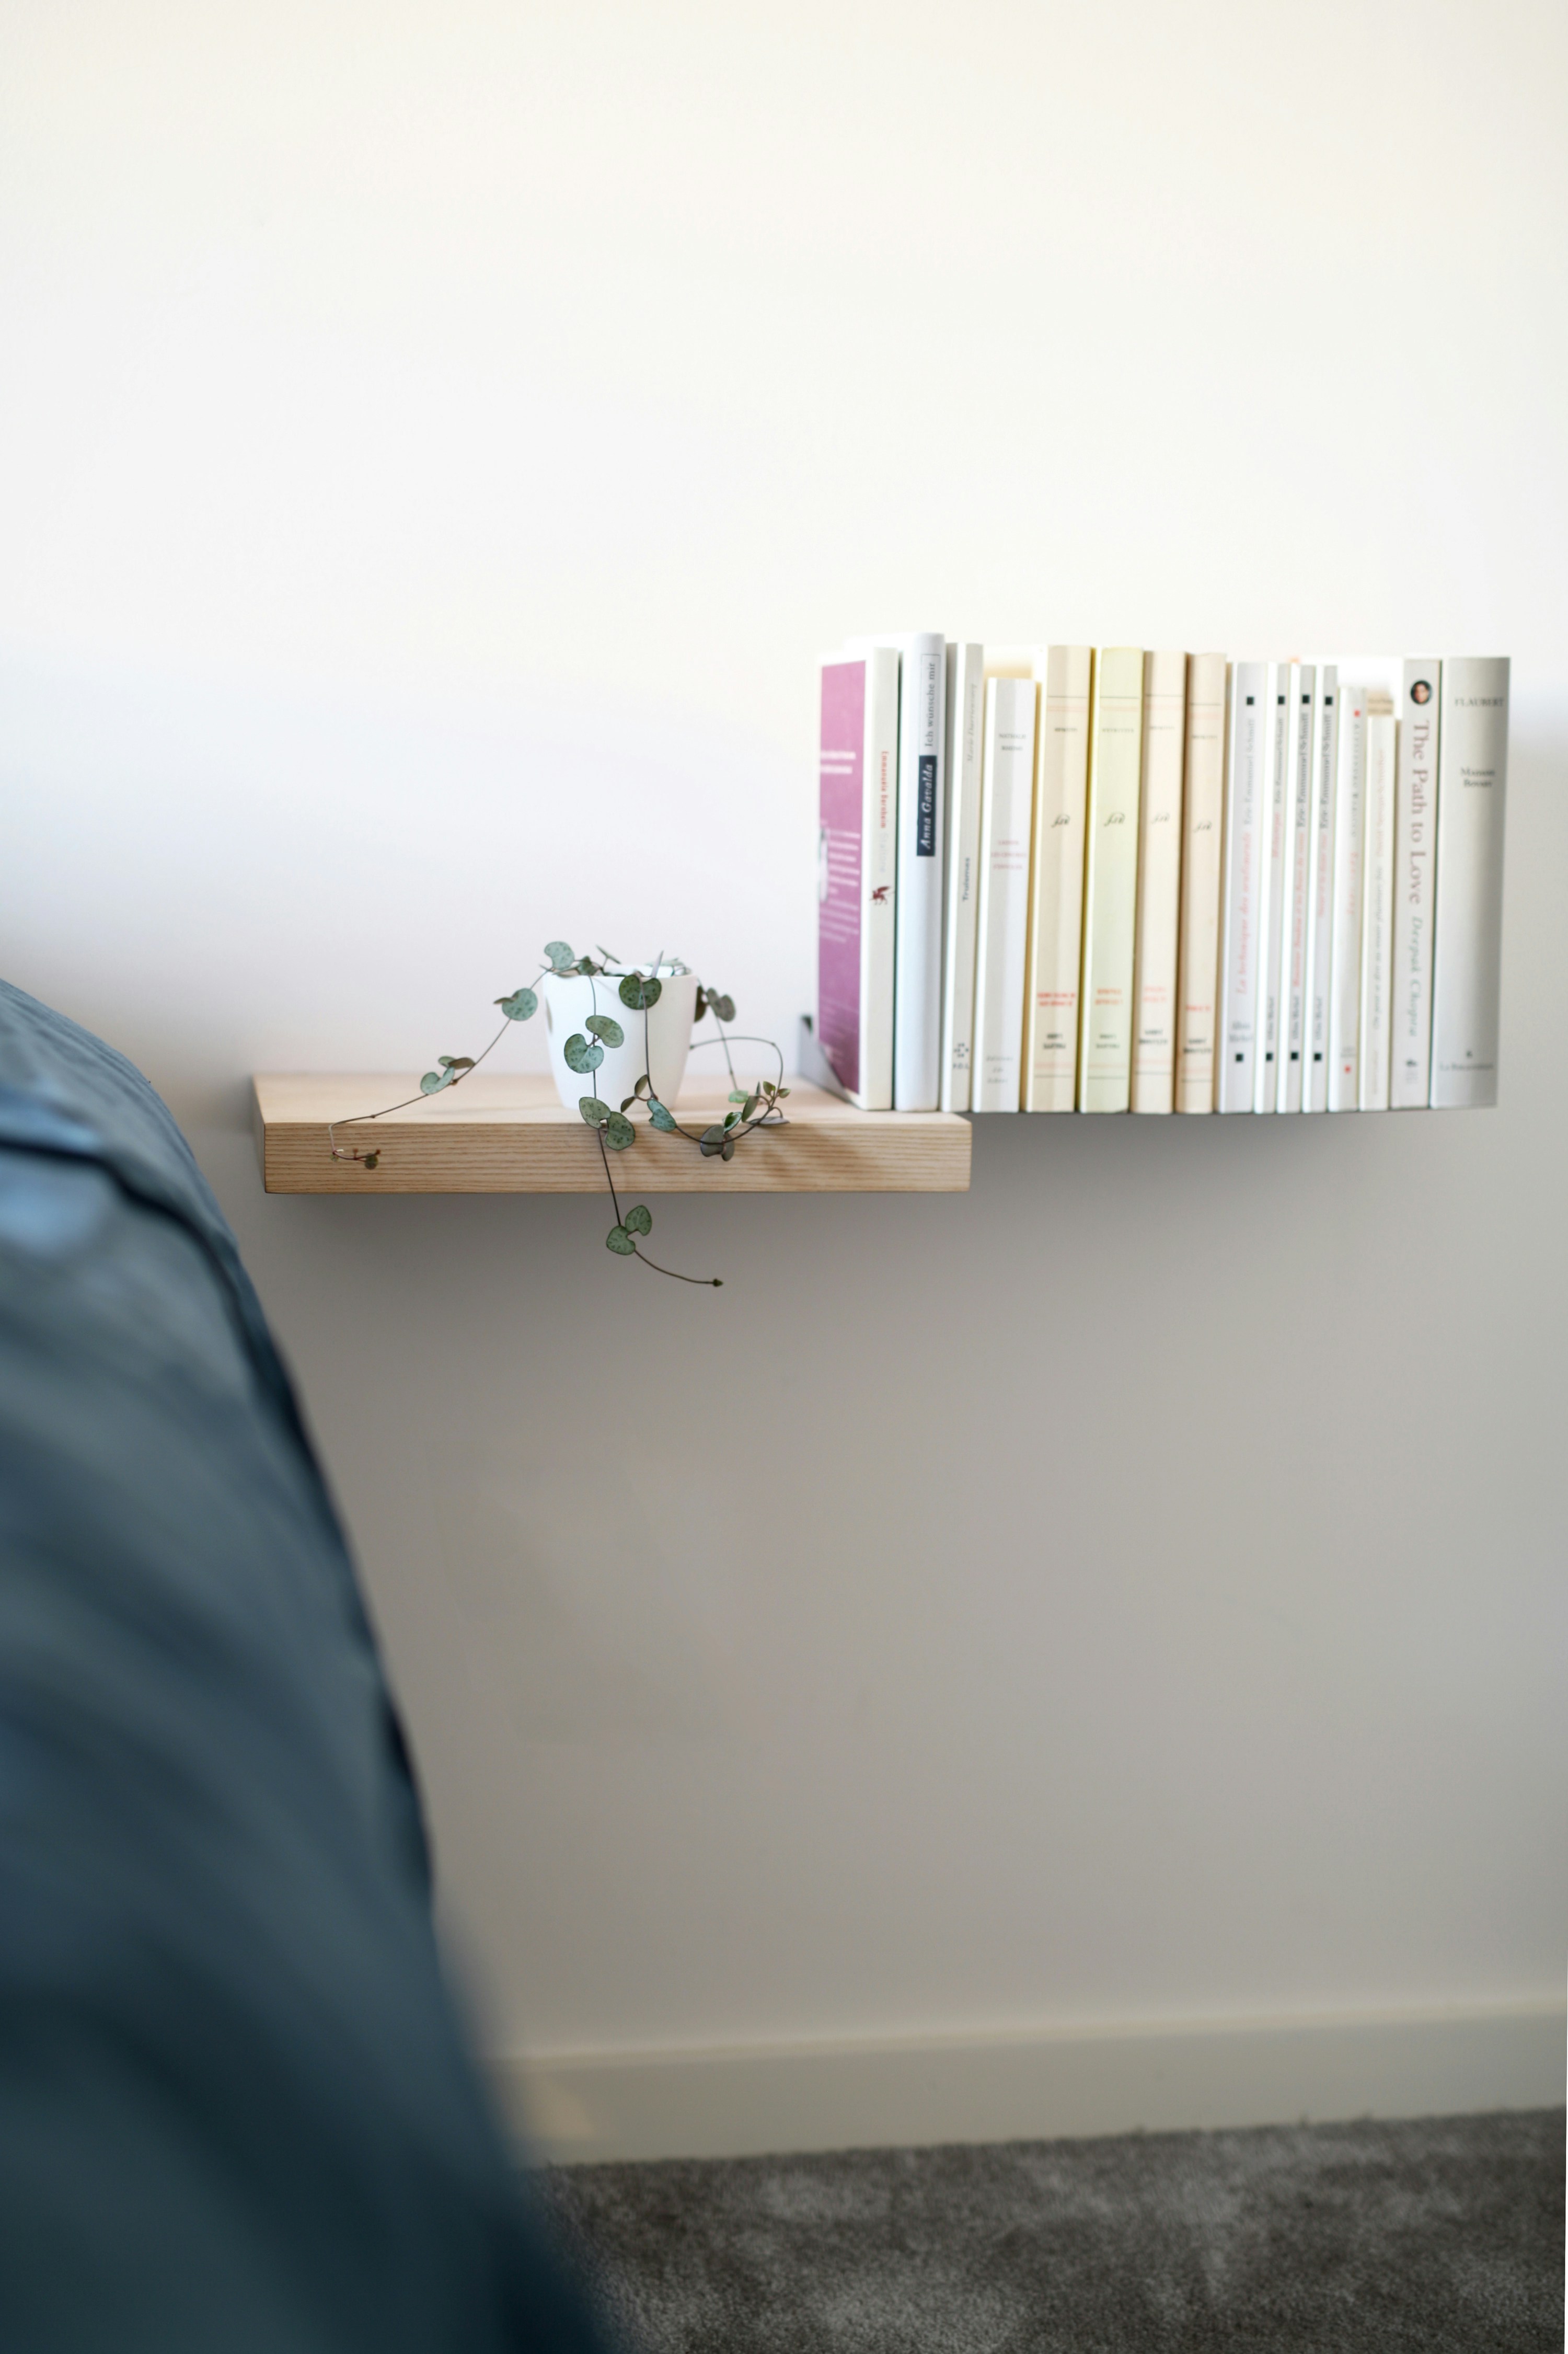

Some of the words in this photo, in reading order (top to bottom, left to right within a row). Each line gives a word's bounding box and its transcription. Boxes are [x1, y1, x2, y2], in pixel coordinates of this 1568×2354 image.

[927, 662, 935, 680] mir
[925, 684, 935, 727] wünsche
[924, 731, 933, 747] Ich
[1413, 720, 1430, 761] The
[921, 763, 933, 813] Gavalda
[1412, 768, 1428, 815] Path
[880, 794, 889, 829] Bernheim
[1411, 822, 1424, 843] to
[920, 817, 931, 850] Anna
[1410, 850, 1426, 905] Love
[1408, 915, 1423, 974] Deepak
[1407, 979, 1422, 1037] Chopra
